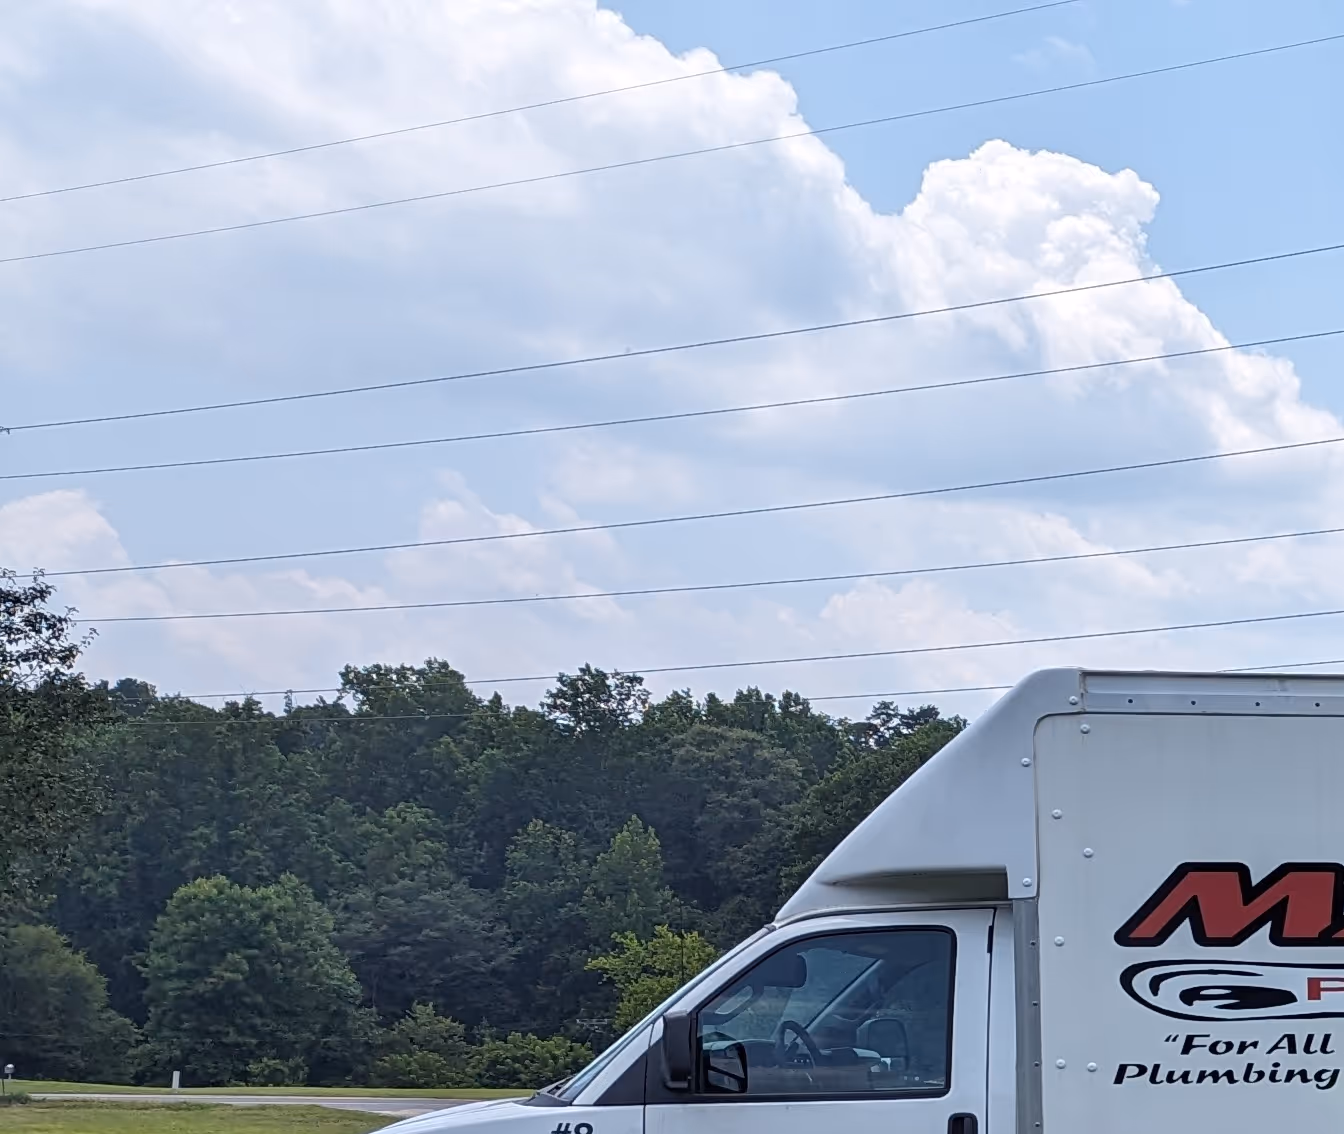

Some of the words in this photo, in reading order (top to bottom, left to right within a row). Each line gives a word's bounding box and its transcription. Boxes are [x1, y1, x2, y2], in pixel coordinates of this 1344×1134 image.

[1163, 1033, 1259, 1056] “For
[1266, 1033, 1335, 1055] All
[1113, 1062, 1341, 1090] Plumbing
